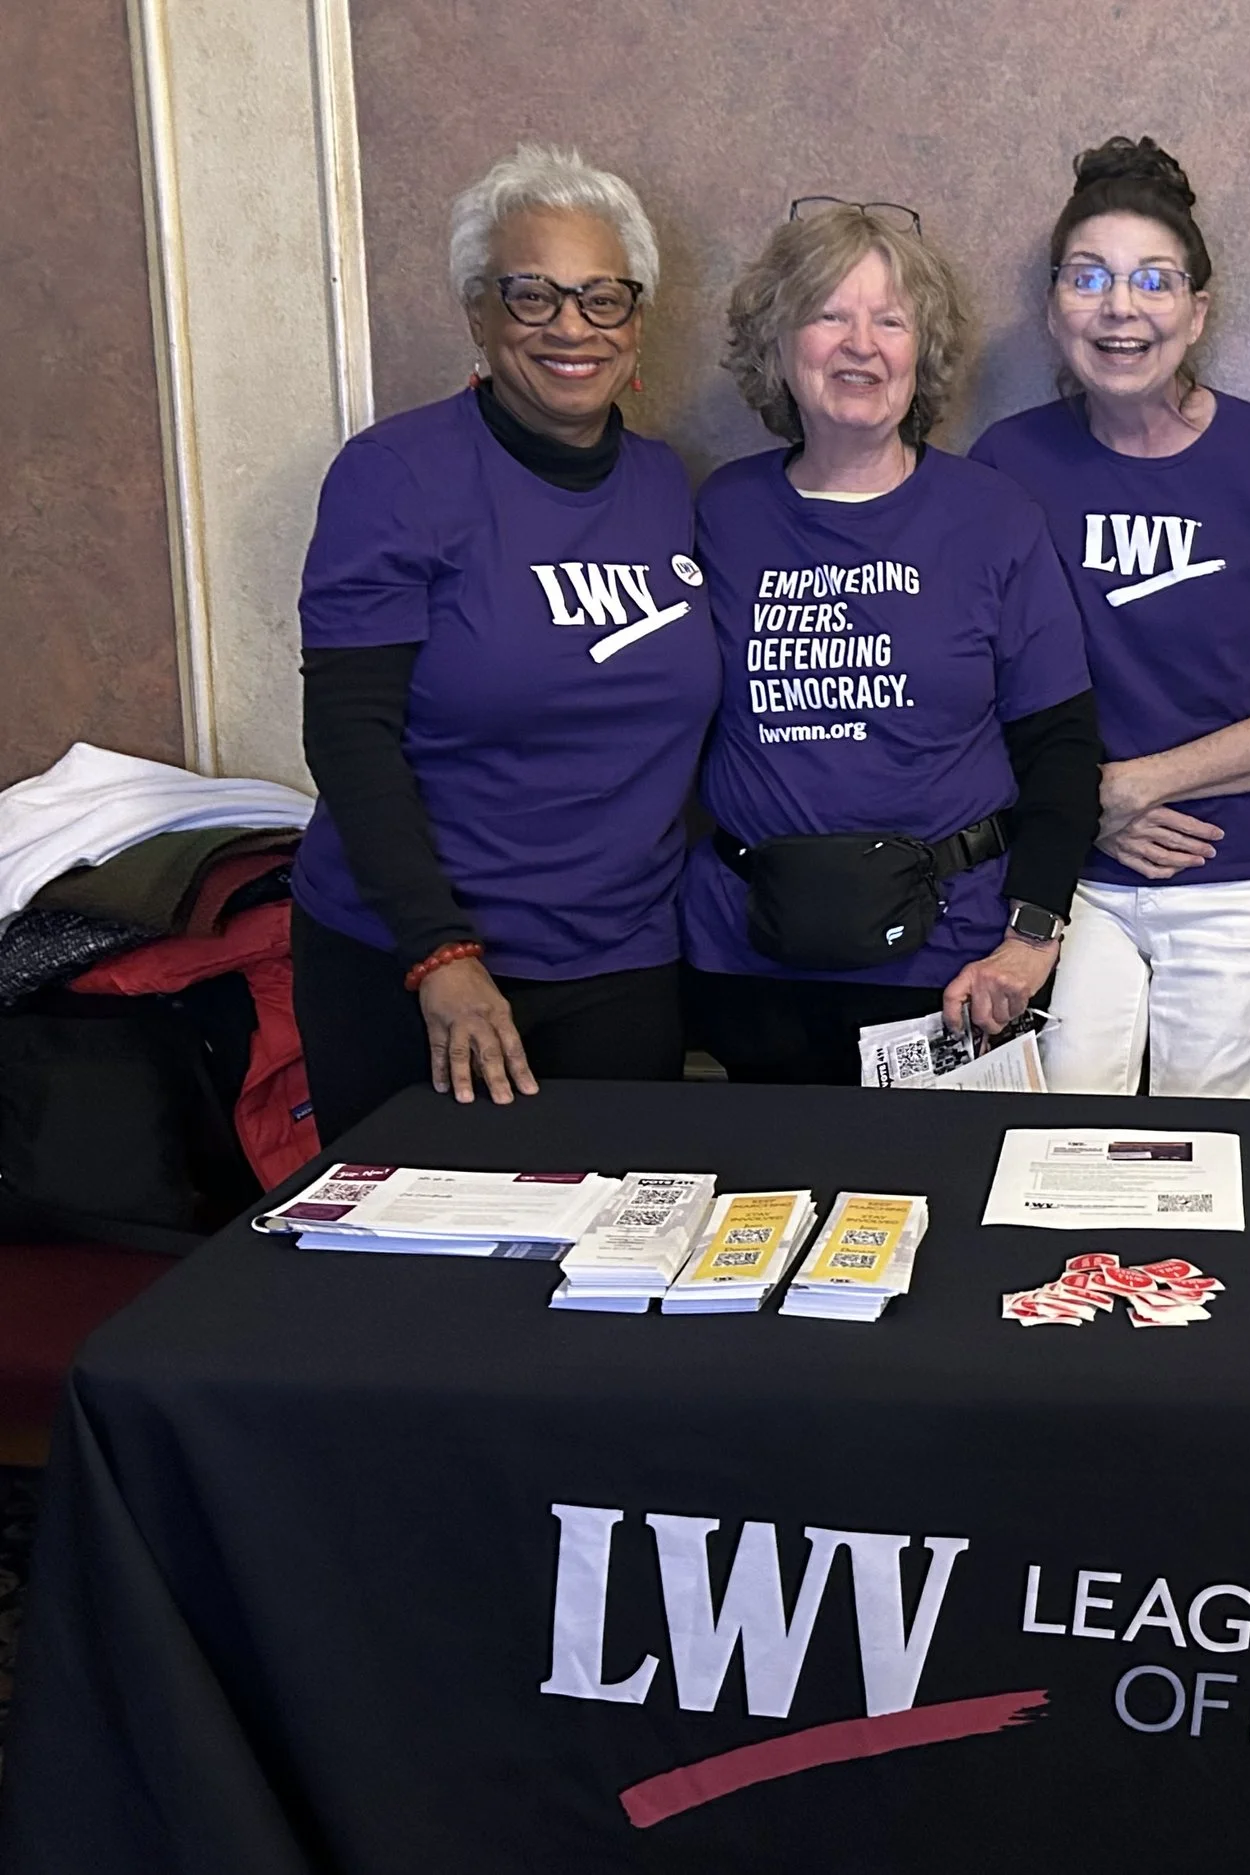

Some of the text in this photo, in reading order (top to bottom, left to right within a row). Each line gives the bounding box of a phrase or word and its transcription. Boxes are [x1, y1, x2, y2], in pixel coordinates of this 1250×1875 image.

[1082, 514, 1200, 576] LWV
[530, 562, 659, 625] LWV
[759, 561, 919, 599] EMPOWERING
[754, 602, 853, 632] VOTERS.
[747, 634, 891, 672] DEFENDING
[750, 674, 914, 713] DEMOCRACY.
[759, 722, 867, 743] lwvmn.org
[541, 1503, 970, 1718] LWV
[1115, 1665, 1238, 1735] OF
